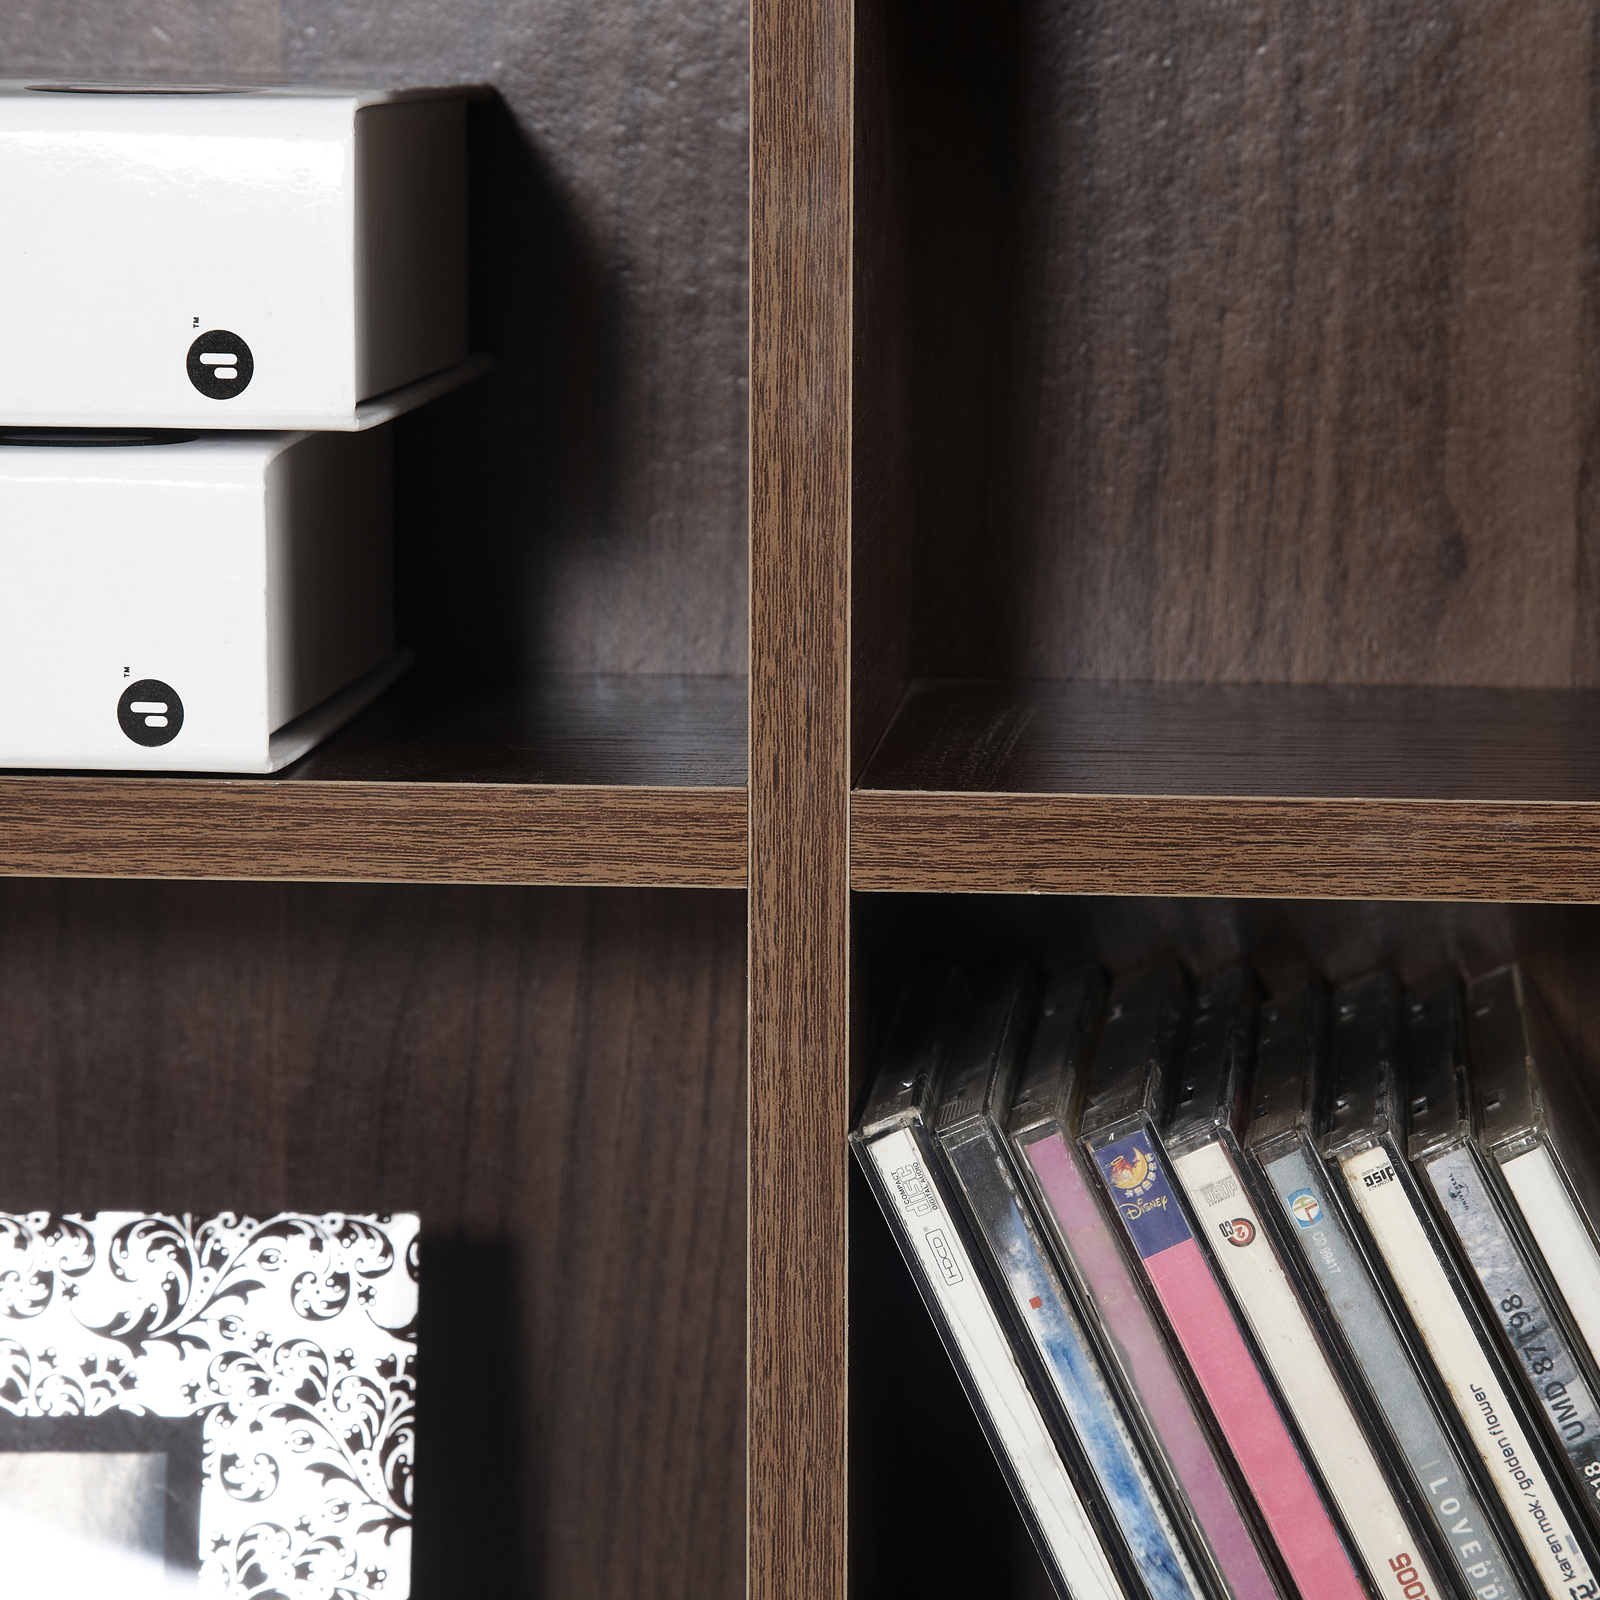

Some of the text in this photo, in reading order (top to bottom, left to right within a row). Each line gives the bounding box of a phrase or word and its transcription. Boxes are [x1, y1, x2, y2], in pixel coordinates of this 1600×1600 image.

[890, 1171, 910, 1205] COMPACT
[895, 1164, 932, 1218] disc
[912, 1162, 939, 1211] DIGITAL AUDIO
[1448, 1172, 1470, 1211] UNIVERSAL
[1219, 1220, 1234, 1238] CD
[1312, 1231, 1342, 1275] CD 99417
[1500, 1293, 1586, 1442] UMD 87198
[1469, 1383, 1505, 1437] flower
[1497, 1436, 1535, 1491] golden
[1528, 1499, 1553, 1534] mok
[1388, 1552, 1431, 1600] 005
[1546, 1533, 1577, 1583] karen
